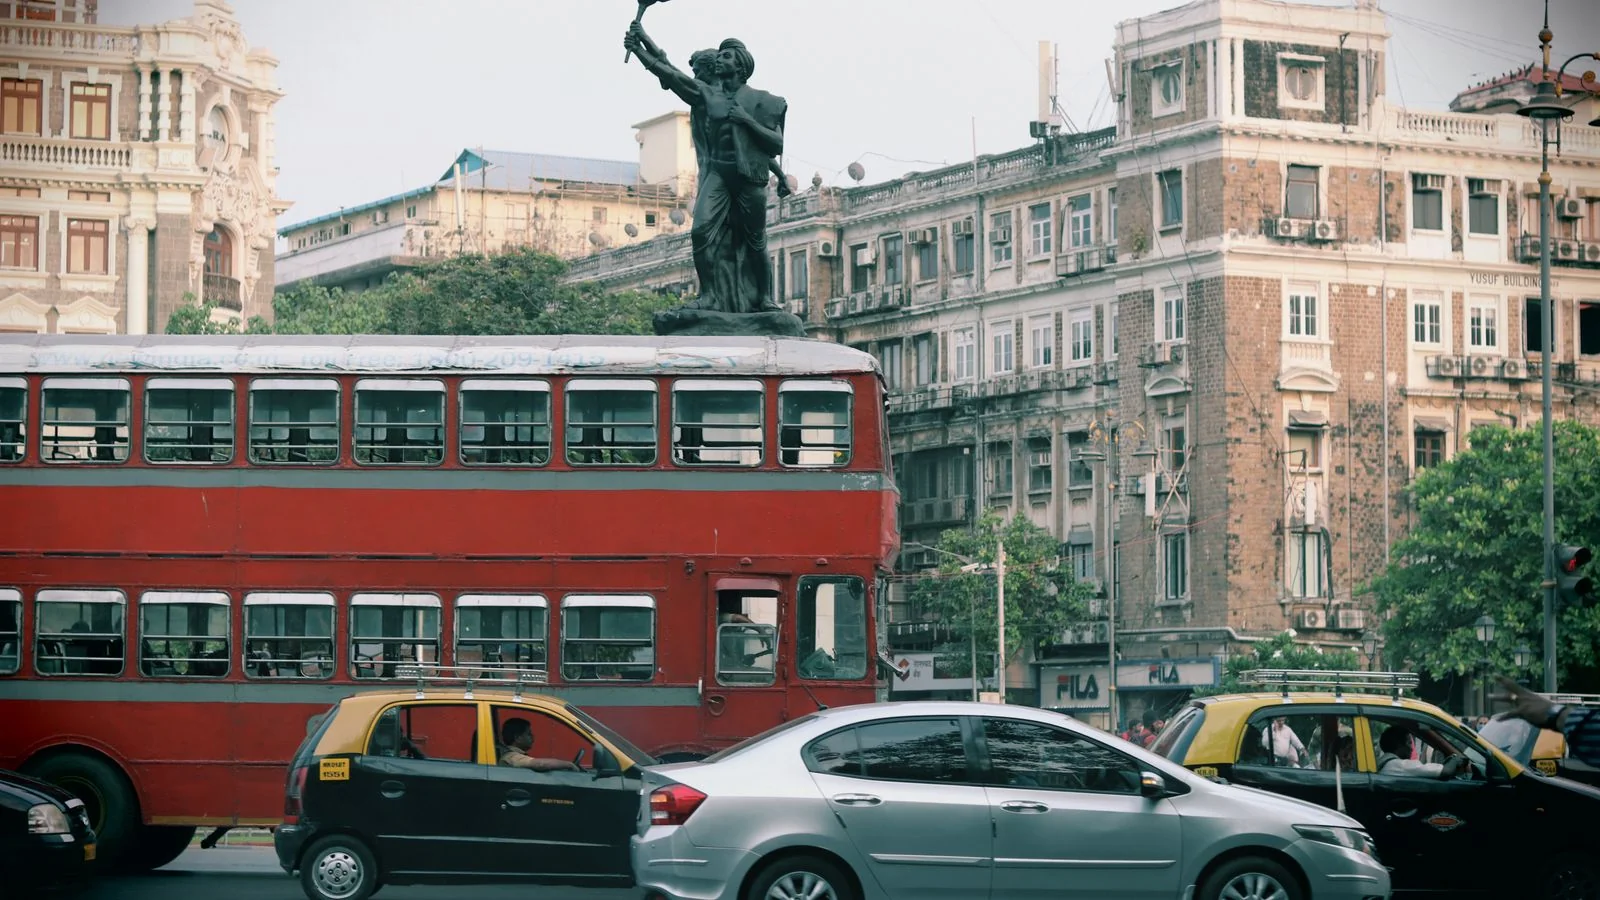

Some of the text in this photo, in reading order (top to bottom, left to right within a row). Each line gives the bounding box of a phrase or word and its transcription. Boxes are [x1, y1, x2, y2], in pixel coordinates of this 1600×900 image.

[1470, 271, 1499, 285] YUSUF
[1149, 664, 1180, 684] FILA
[1057, 674, 1099, 700] FILA
